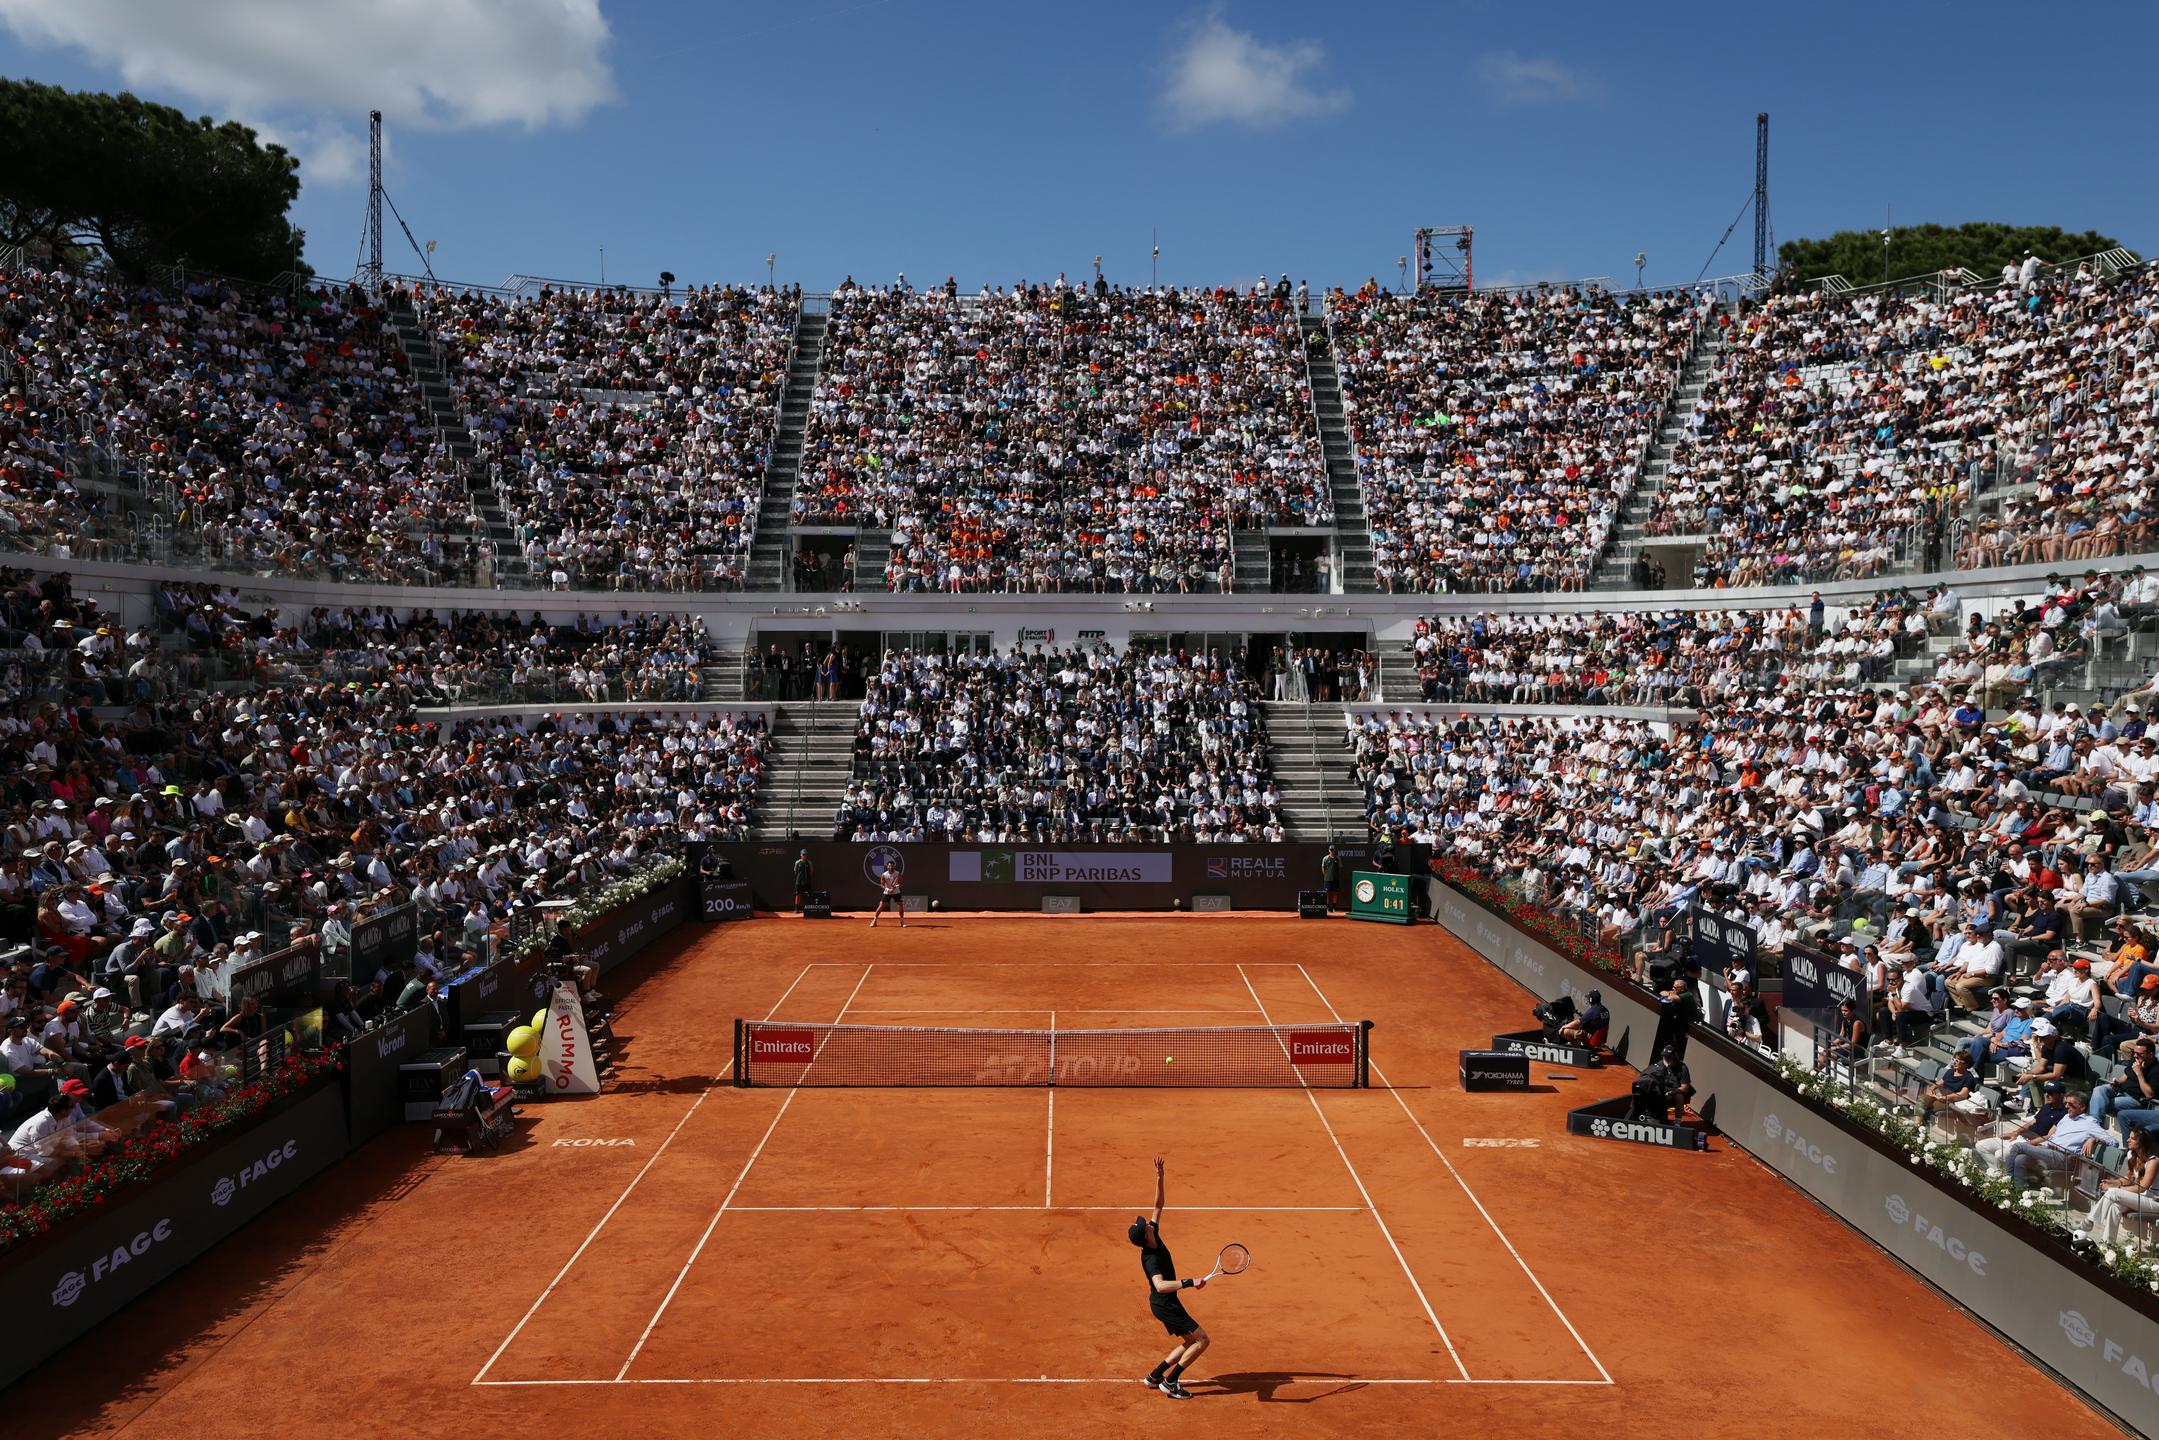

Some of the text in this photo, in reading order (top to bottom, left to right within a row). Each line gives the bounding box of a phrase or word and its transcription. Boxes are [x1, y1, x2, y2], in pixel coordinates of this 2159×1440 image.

[1078, 630, 1106, 638] FITP
[1023, 853, 1059, 866] BNL
[1231, 857, 1285, 869] REALE
[1023, 867, 1142, 881] BNP PARIBAS
[1231, 869, 1285, 878] MUTUA
[1383, 886, 1405, 894] ROLEX
[657, 902, 675, 919] FAGE
[706, 898, 735, 912] 200
[1049, 898, 1073, 909] EA7
[1200, 898, 1222, 909] EA7
[358, 927, 383, 949] VALMORA
[626, 920, 645, 940] FAGE
[1699, 916, 1720, 940] VALMORA
[1725, 928, 1749, 953] VALMORA
[282, 955, 312, 982] VALMORA
[1522, 954, 1545, 977] FAGE
[1790, 955, 1818, 984] VALMORA
[1825, 971, 1857, 1001] VALMORA
[378, 1027, 406, 1059] Veroni
[555, 1014, 576, 1090] RUMMO
[754, 1040, 811, 1053] Emirates
[1293, 1042, 1350, 1055] Emirates
[1524, 1044, 1573, 1064] emu
[551, 1138, 636, 1147] ROMA
[1463, 1137, 1541, 1148] FAGE
[1611, 1121, 1674, 1146] emu
[1783, 1126, 1838, 1175] FAGE
[239, 1139, 298, 1189] FAGE
[91, 1217, 173, 1283] FAGE
[1914, 1213, 1989, 1277] FAGE
